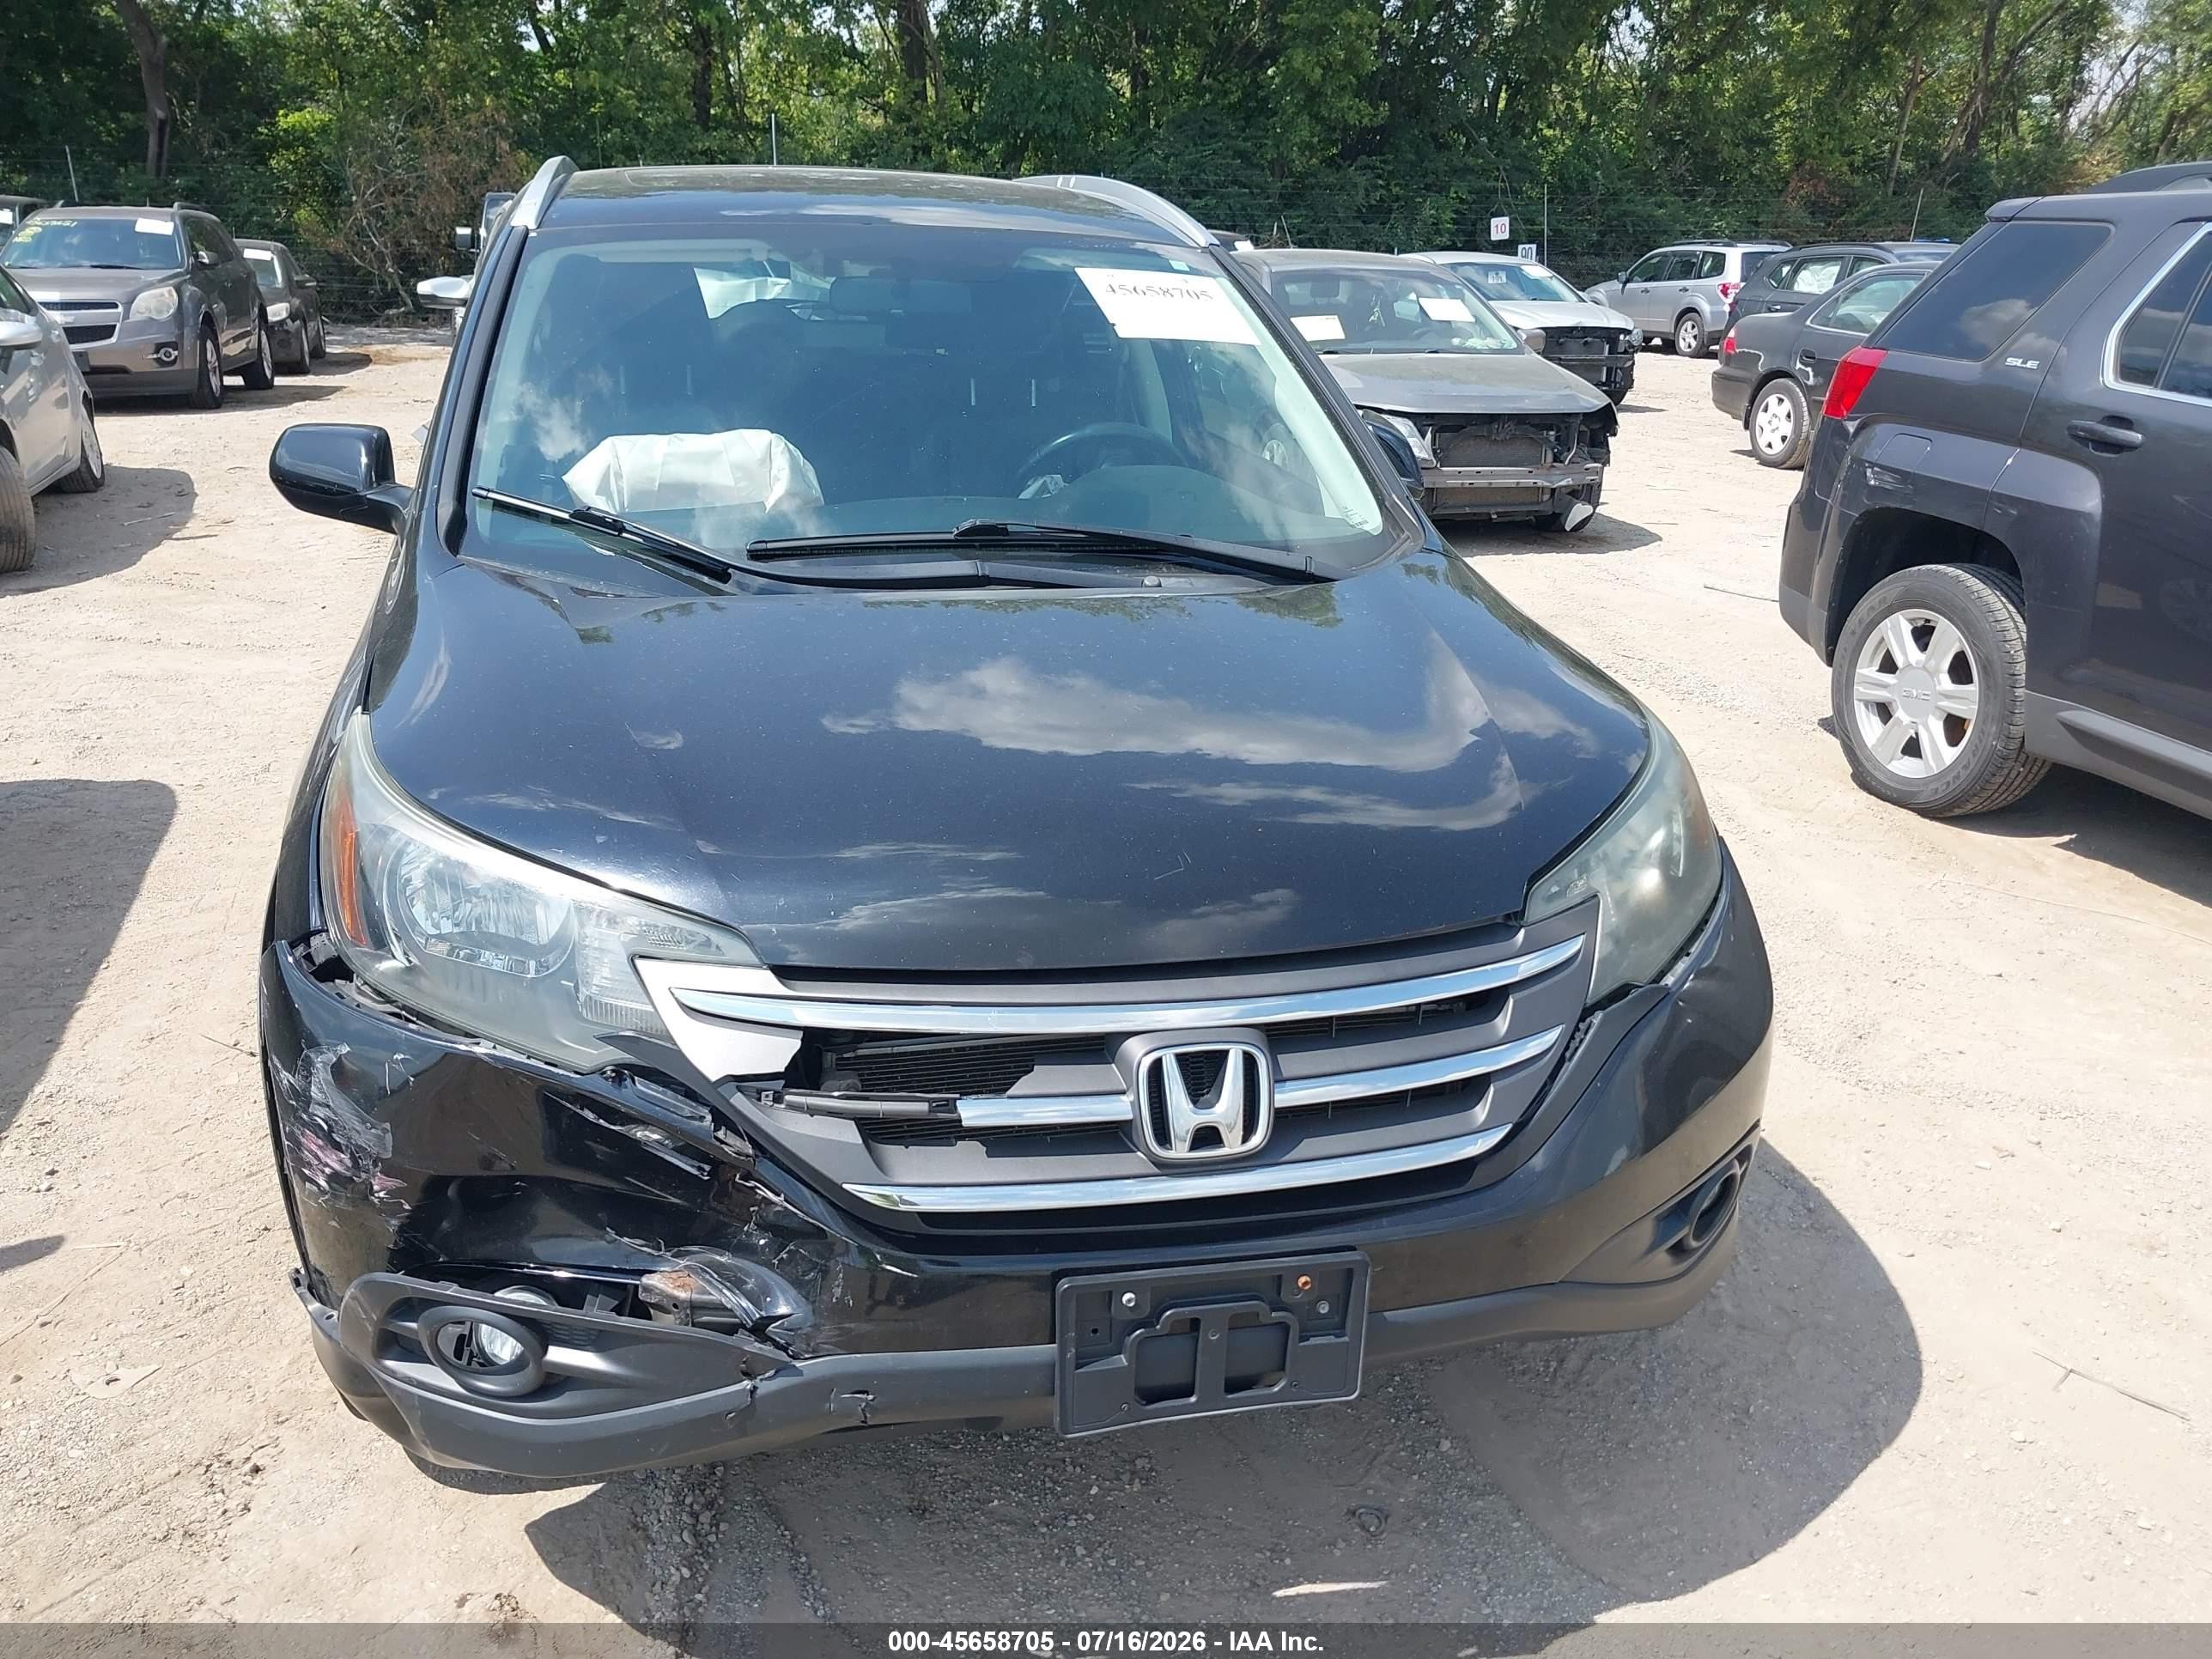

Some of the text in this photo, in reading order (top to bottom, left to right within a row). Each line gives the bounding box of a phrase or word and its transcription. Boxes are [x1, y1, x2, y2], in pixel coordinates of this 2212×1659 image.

[1494, 223, 1507, 234] 10
[1106, 283, 1213, 301] 45658705
[2005, 357, 2039, 369] SLE
[1902, 689, 1931, 701] GMC
